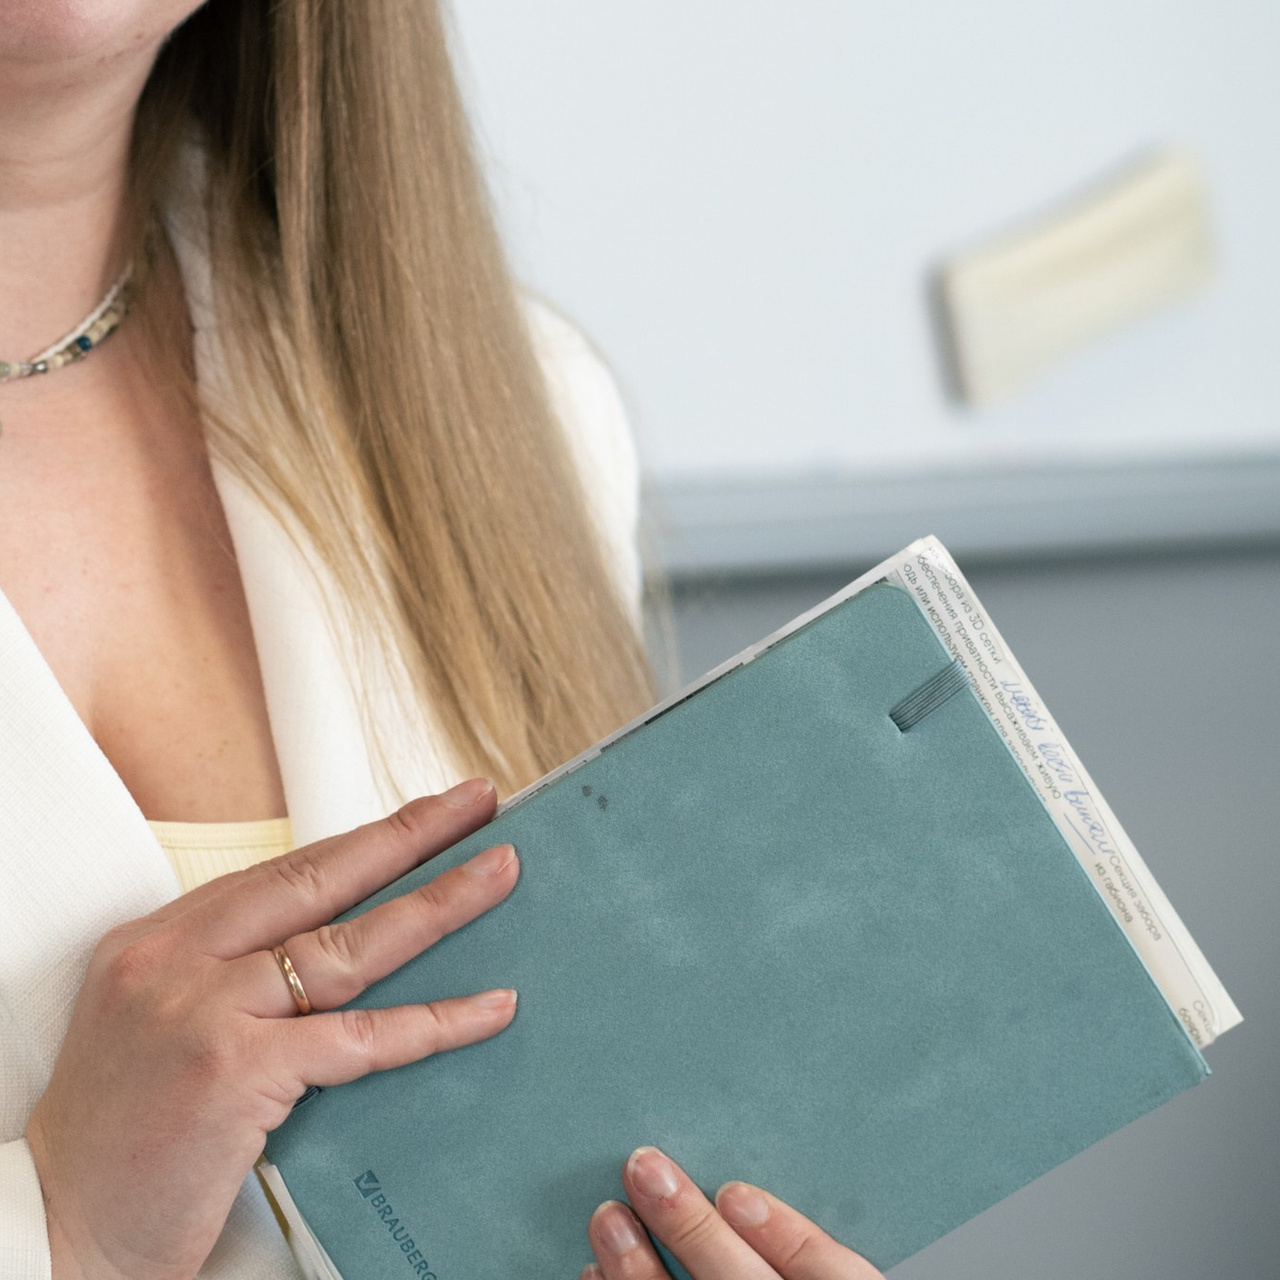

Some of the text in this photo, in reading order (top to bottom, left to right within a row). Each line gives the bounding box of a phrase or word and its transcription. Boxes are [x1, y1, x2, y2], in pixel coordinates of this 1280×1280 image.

[915, 586, 930, 605] или
[961, 600, 972, 613] из
[969, 613, 984, 630] 3D
[979, 631, 1003, 665] сетки
[954, 621, 998, 690] приватности
[995, 691, 1038, 760] высаживаем
[1036, 763, 1061, 799] живую
[1103, 877, 1133, 923] габиона
[1109, 853, 1161, 941] Секция забора
